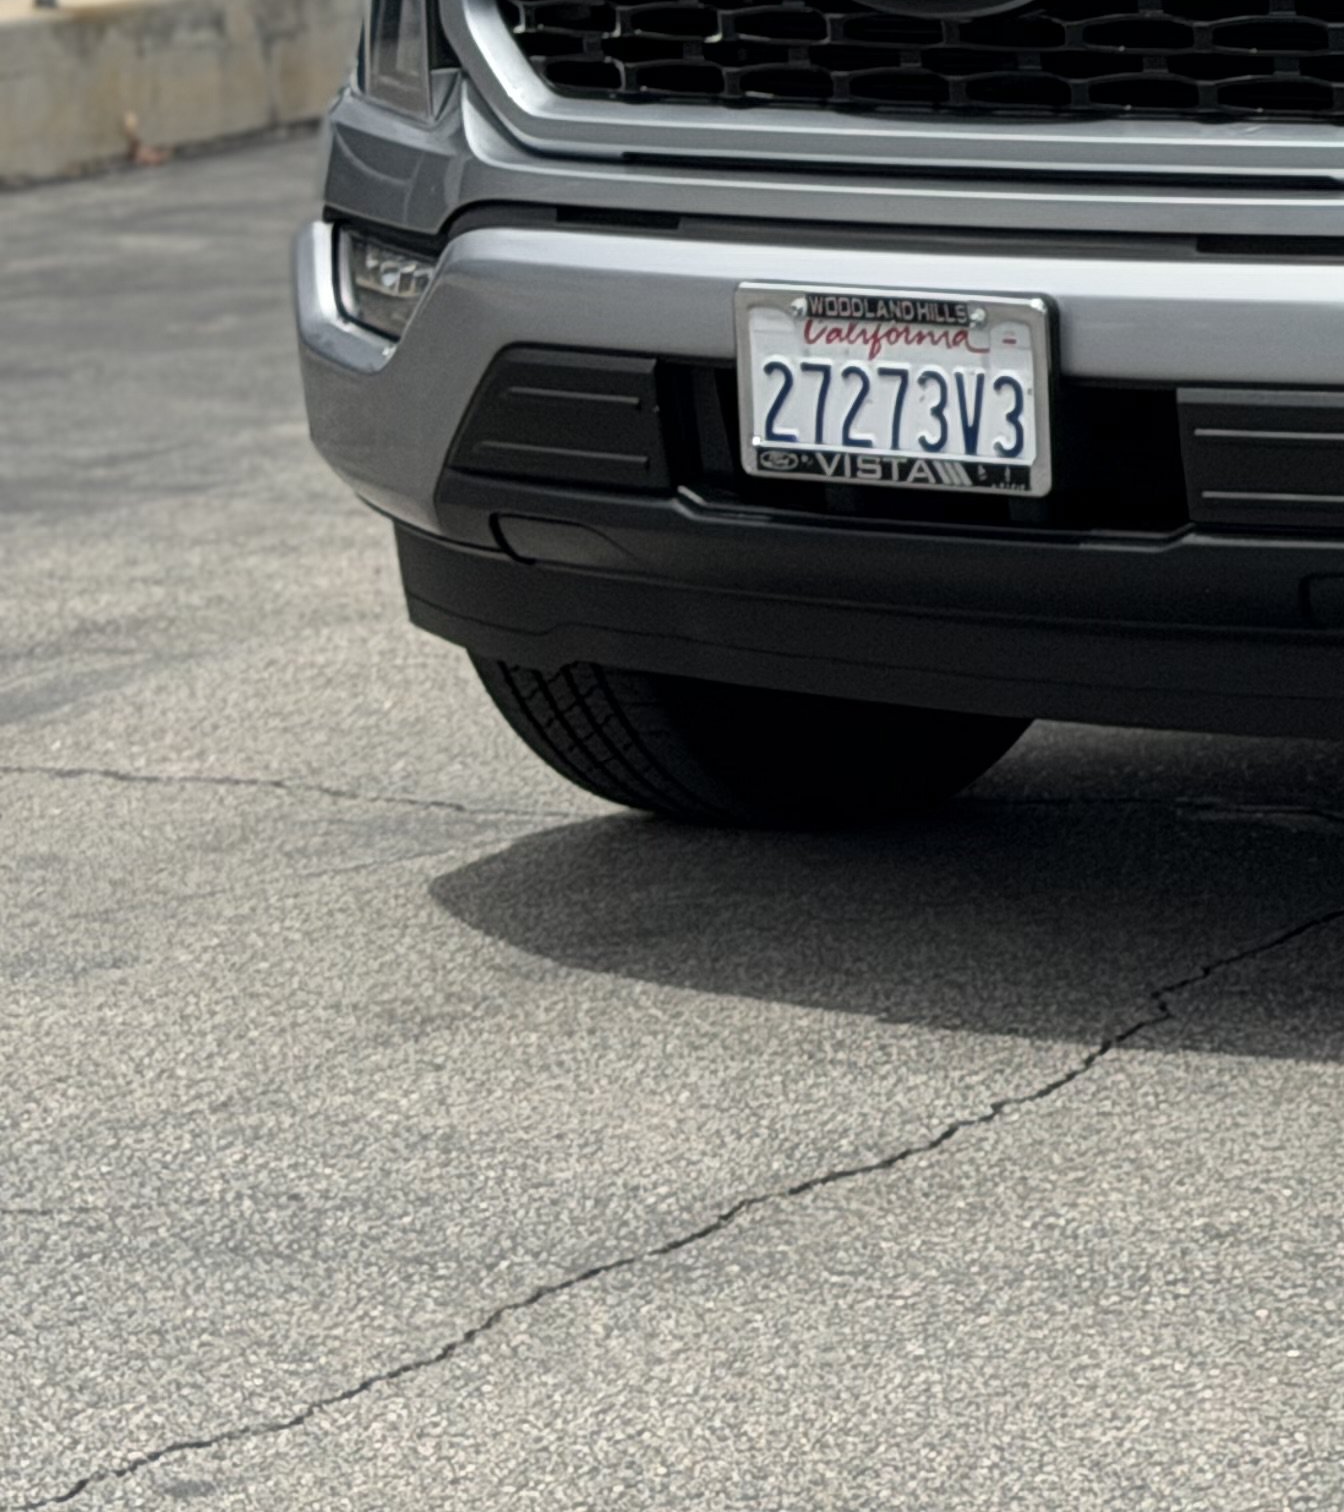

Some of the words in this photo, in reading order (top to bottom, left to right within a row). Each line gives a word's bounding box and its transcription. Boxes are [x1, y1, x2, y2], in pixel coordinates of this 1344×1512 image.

[809, 296, 914, 320] WOODLAND
[917, 301, 968, 323] HILLS
[803, 318, 991, 361] California
[762, 361, 1024, 458] 27273V3
[811, 451, 937, 485] VISTA
